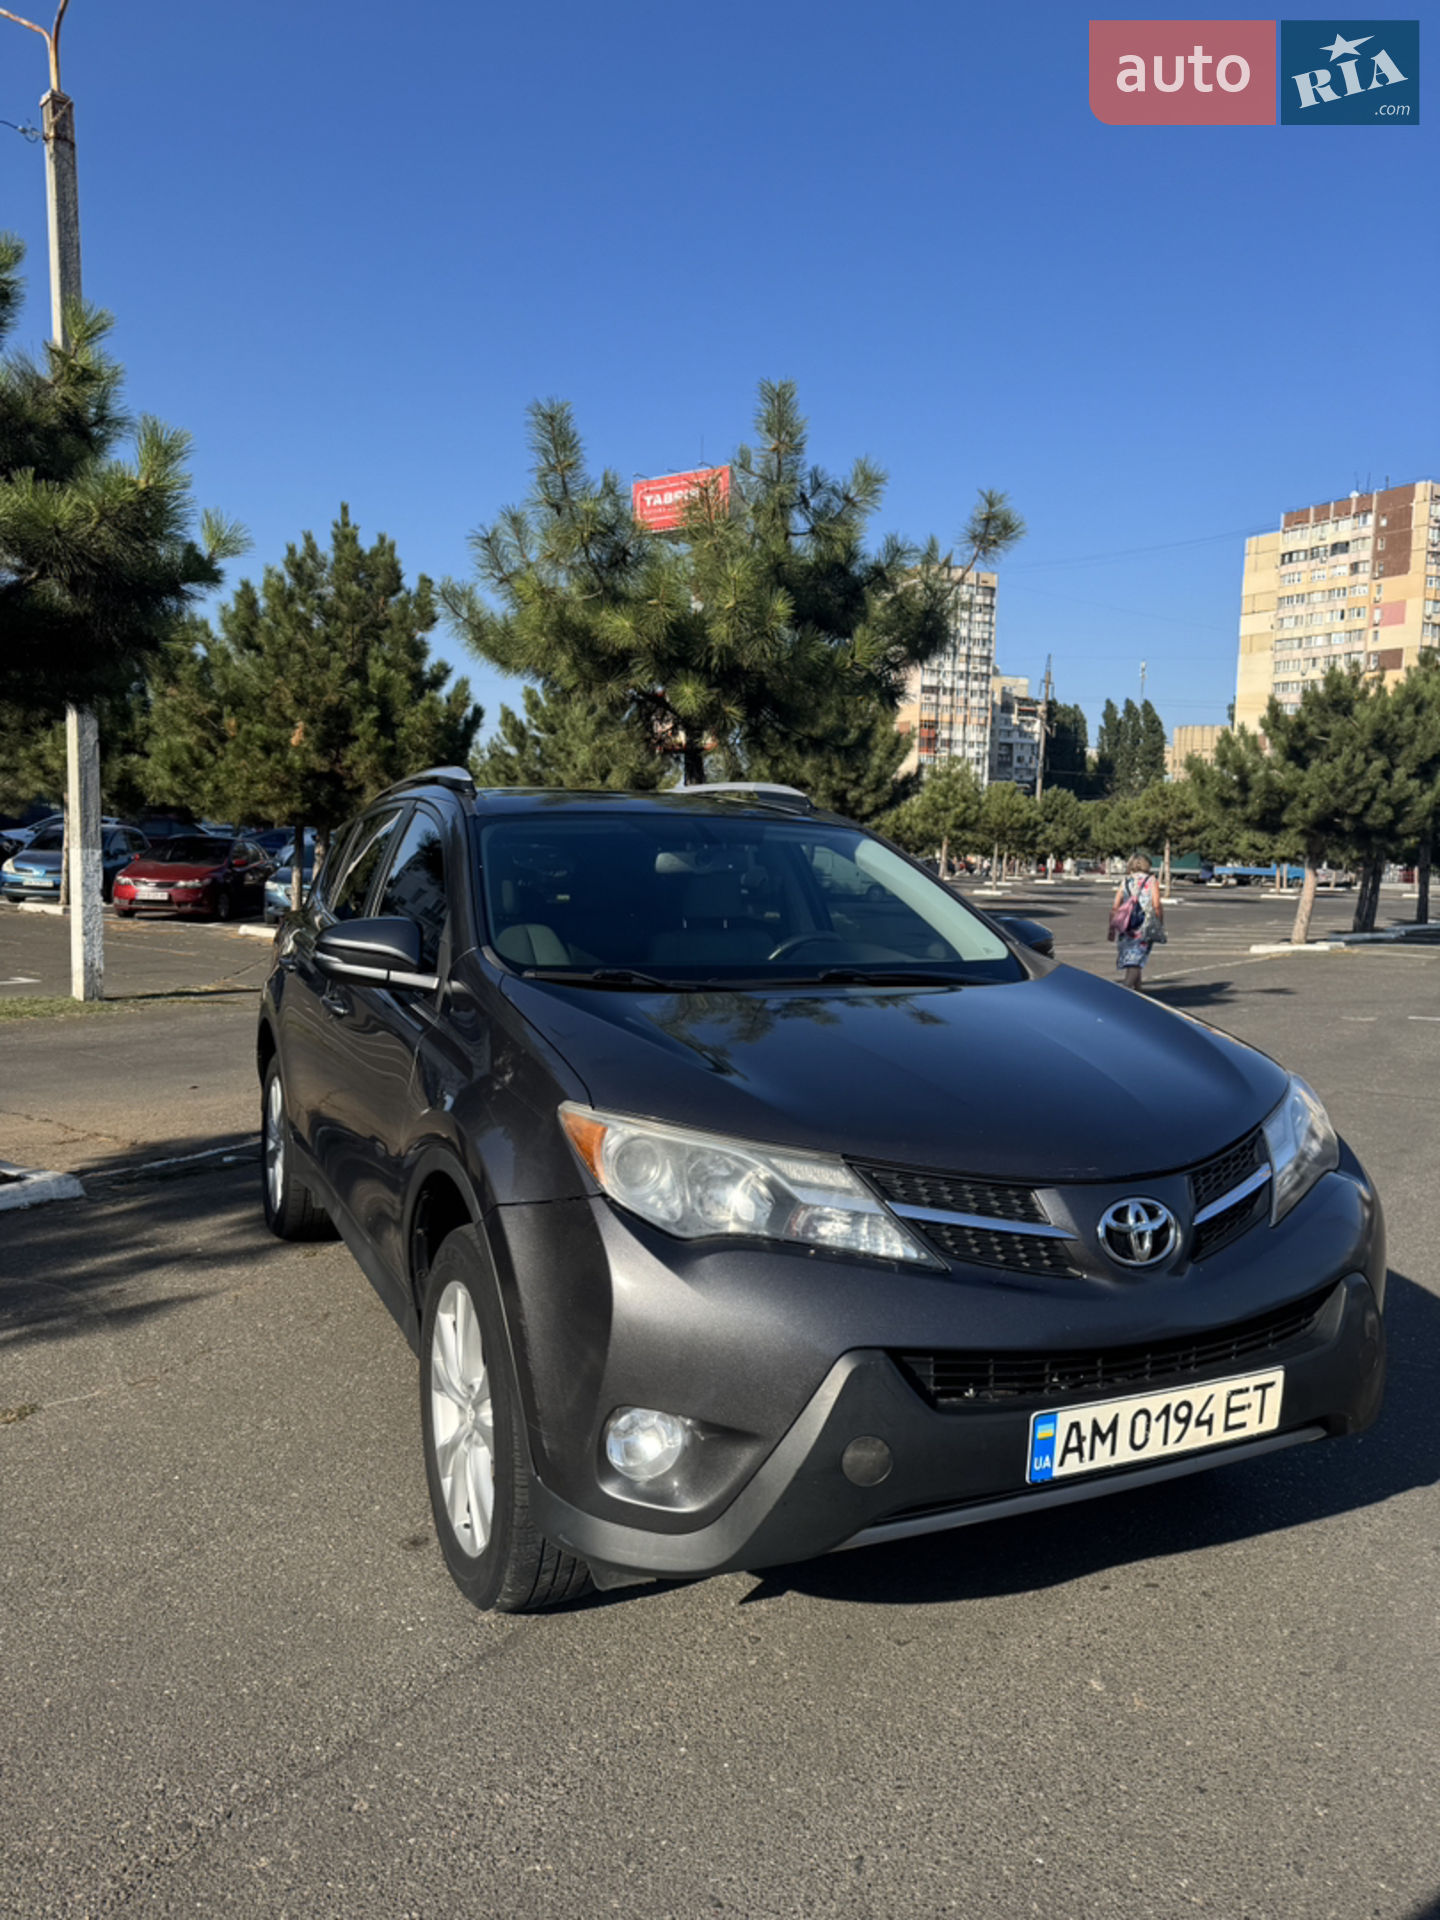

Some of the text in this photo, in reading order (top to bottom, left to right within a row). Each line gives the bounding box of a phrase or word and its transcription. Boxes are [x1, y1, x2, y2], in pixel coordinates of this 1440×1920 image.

[1058, 1381, 1276, 1468] AM 0194 ET
[1033, 1456, 1052, 1471] UA
